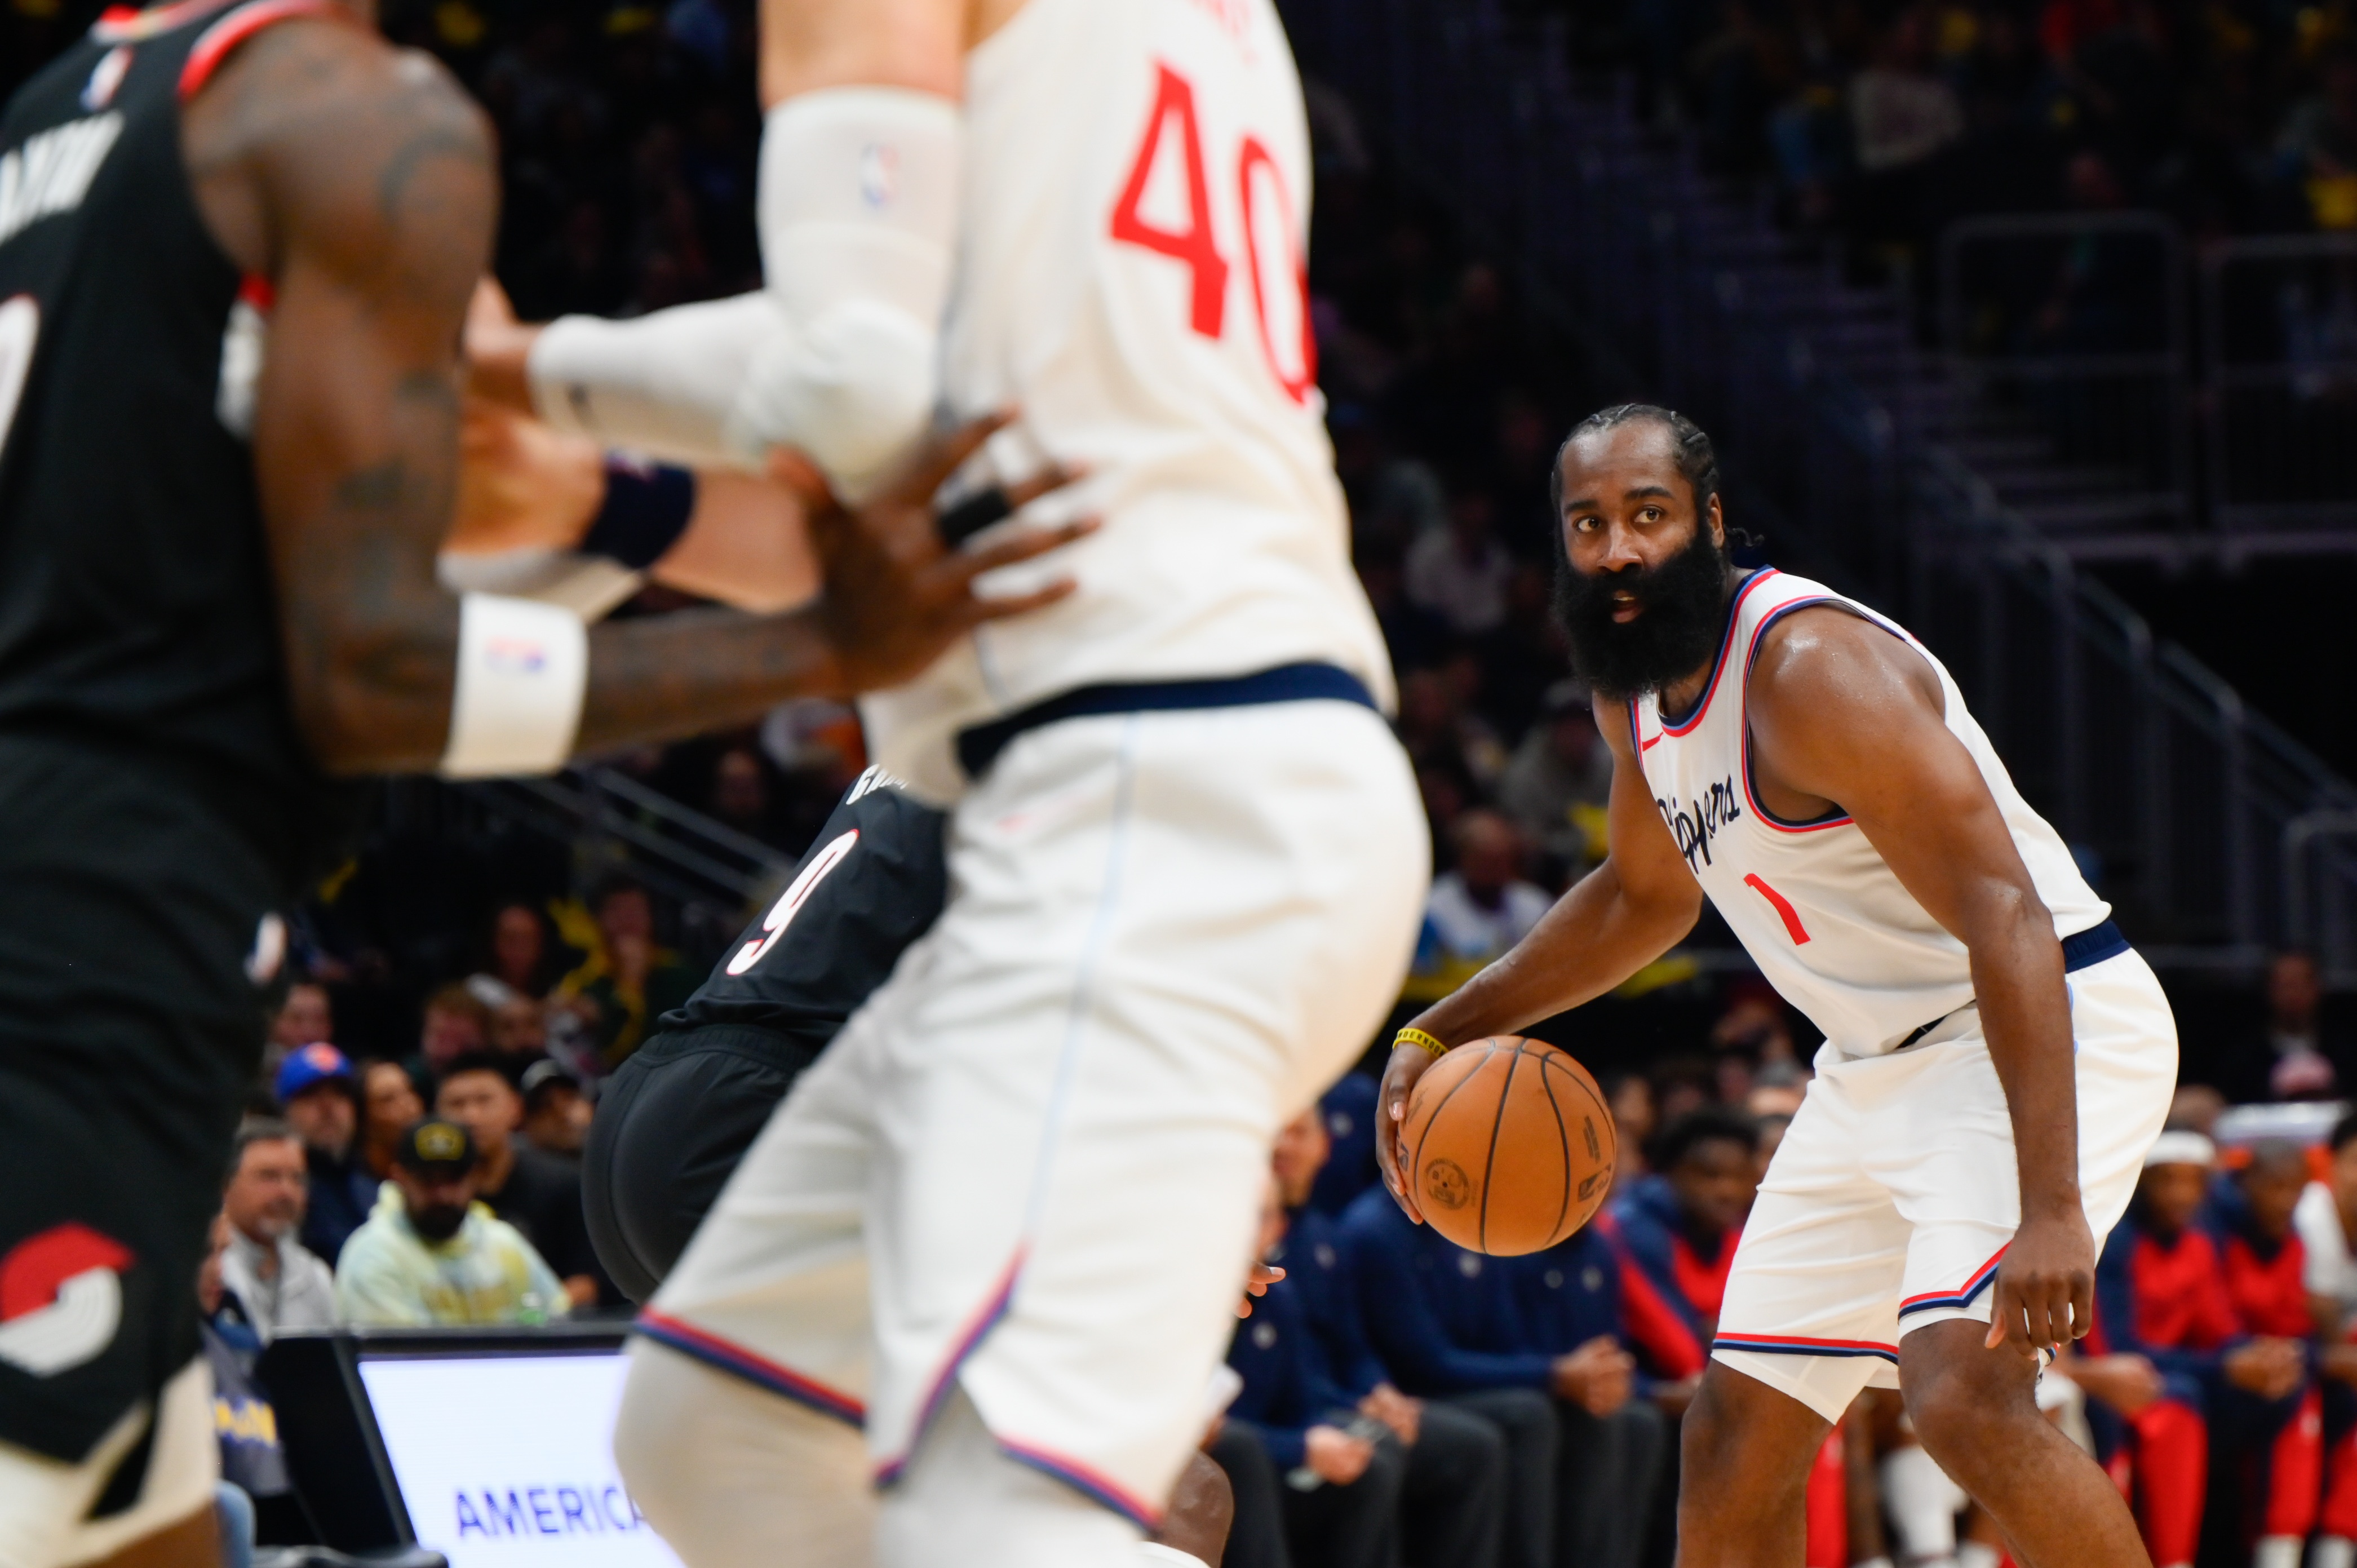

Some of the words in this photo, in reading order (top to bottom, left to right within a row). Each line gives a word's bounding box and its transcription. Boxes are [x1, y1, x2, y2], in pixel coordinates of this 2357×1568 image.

[1108, 57, 1319, 407] 40
[726, 829, 859, 976] 9
[1743, 872, 1811, 946] 1
